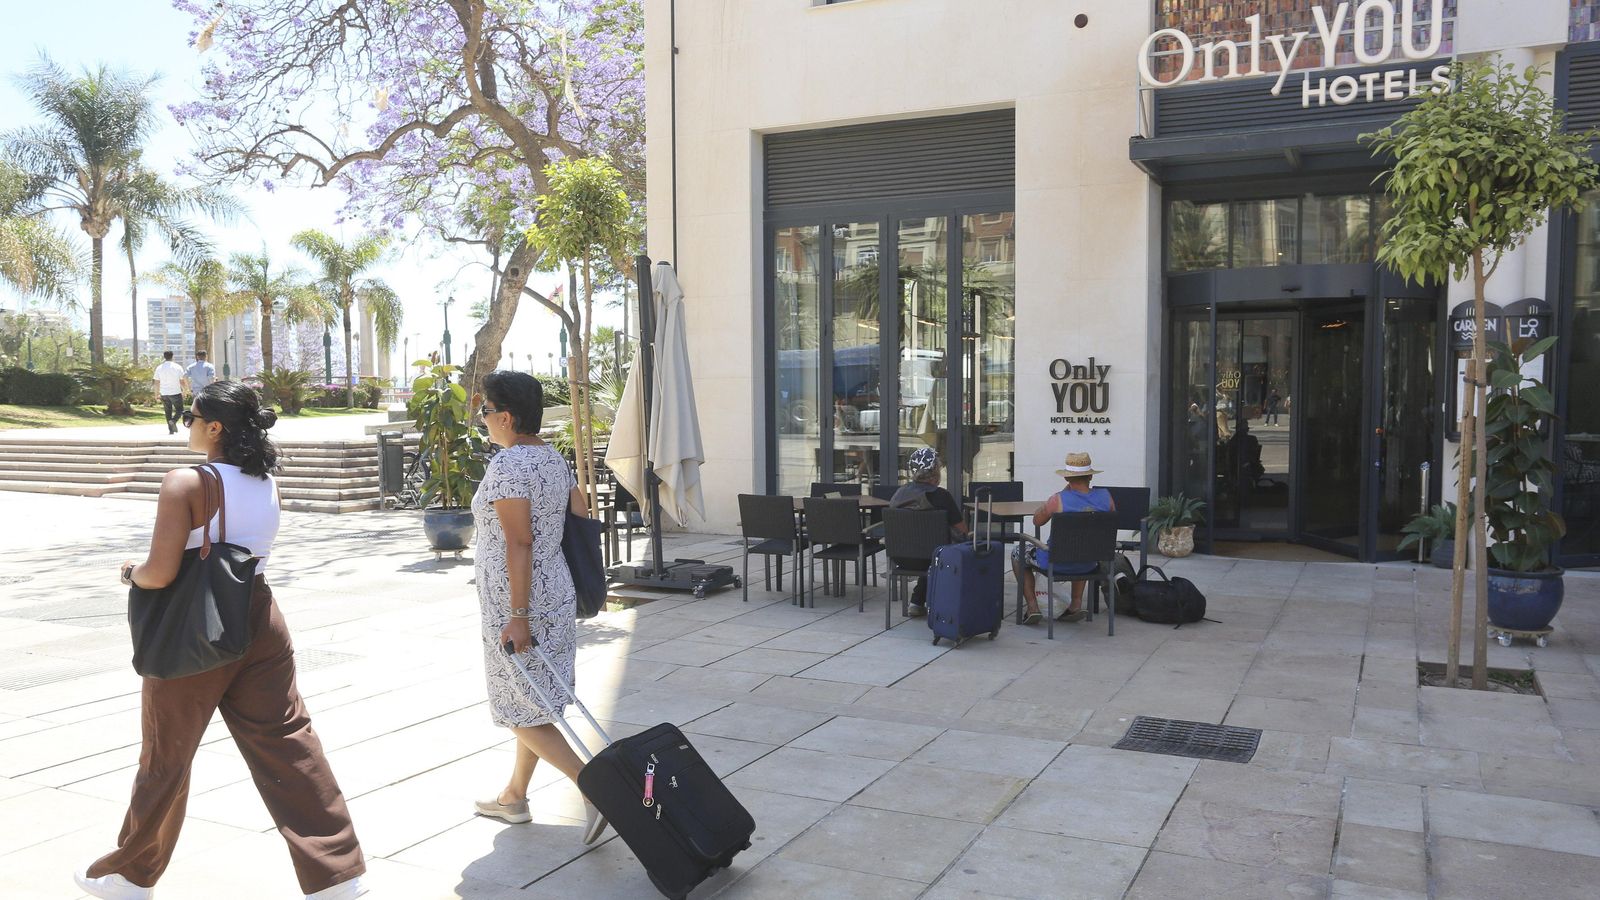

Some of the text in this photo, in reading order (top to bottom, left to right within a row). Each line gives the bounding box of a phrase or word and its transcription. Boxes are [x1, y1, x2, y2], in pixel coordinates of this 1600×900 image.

[1138, 0, 1443, 97] Only YOU
[1302, 65, 1452, 108] HOTELS
[1049, 356, 1111, 387] Only
[1051, 382, 1109, 413] YOU
[1077, 414, 1111, 423] MÁLAGA
